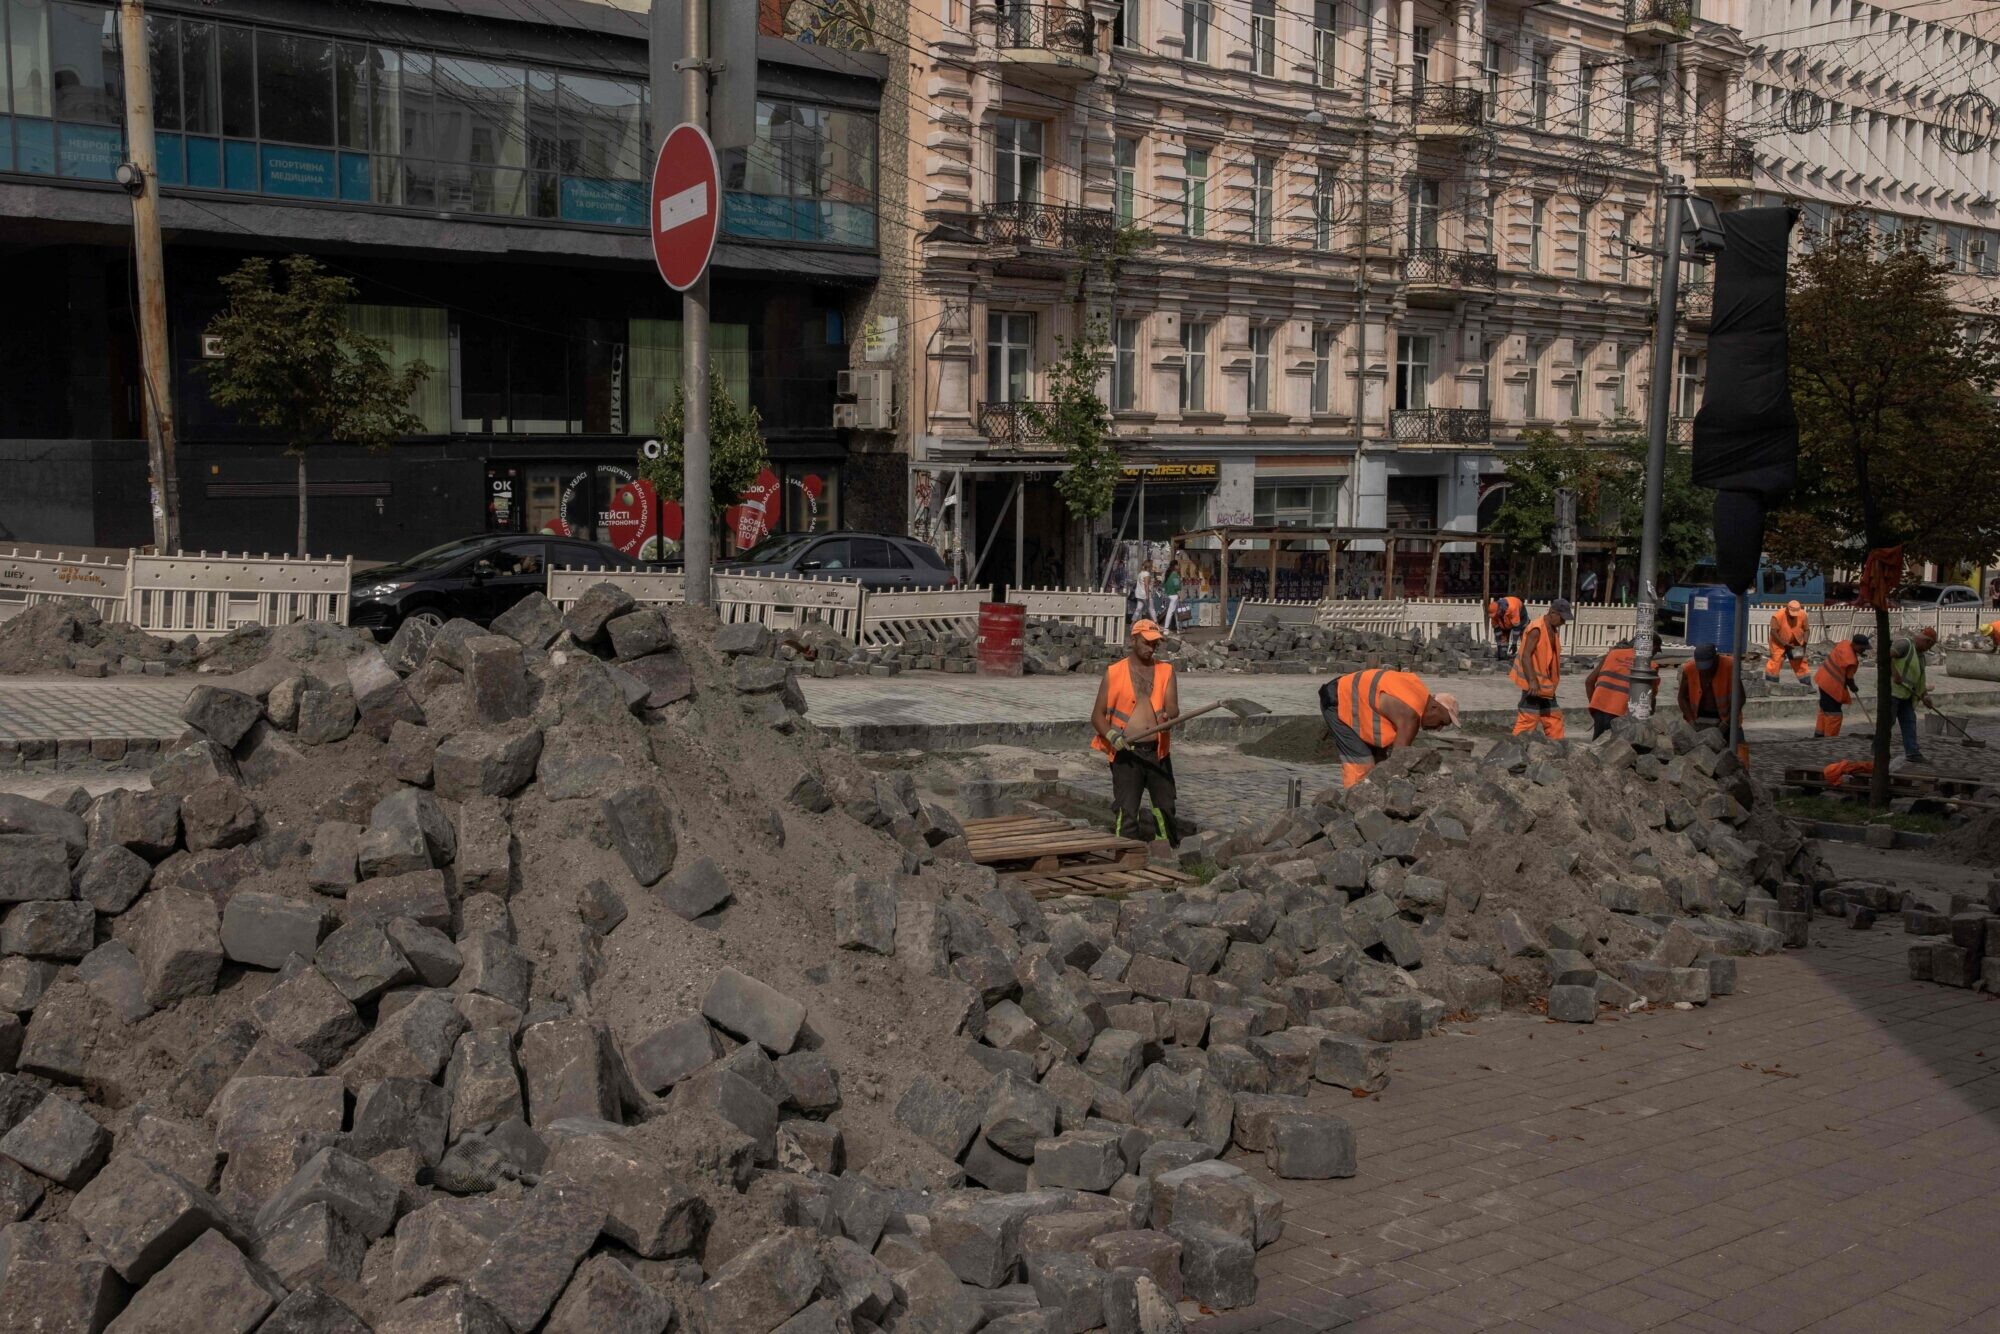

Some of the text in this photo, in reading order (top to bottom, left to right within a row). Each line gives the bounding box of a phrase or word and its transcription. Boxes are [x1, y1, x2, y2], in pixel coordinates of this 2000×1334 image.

[269, 159, 325, 173] СПОРТИВНА
[270, 171, 324, 184] МЕДИЦИНА
[597, 465, 632, 481] ПРОДУКТИ
[1188, 464, 1216, 475] CAFE
[569, 471, 587, 488] ХЕЛСІ
[560, 488, 572, 528] ПРОДУКТИ
[598, 510, 631, 520] ТЕЙСТІ
[636, 499, 649, 538] ПРОДУКТИ
[598, 519, 640, 527] ГАСТРОНОМІЯ
[4, 570, 25, 580] ШЕУ
